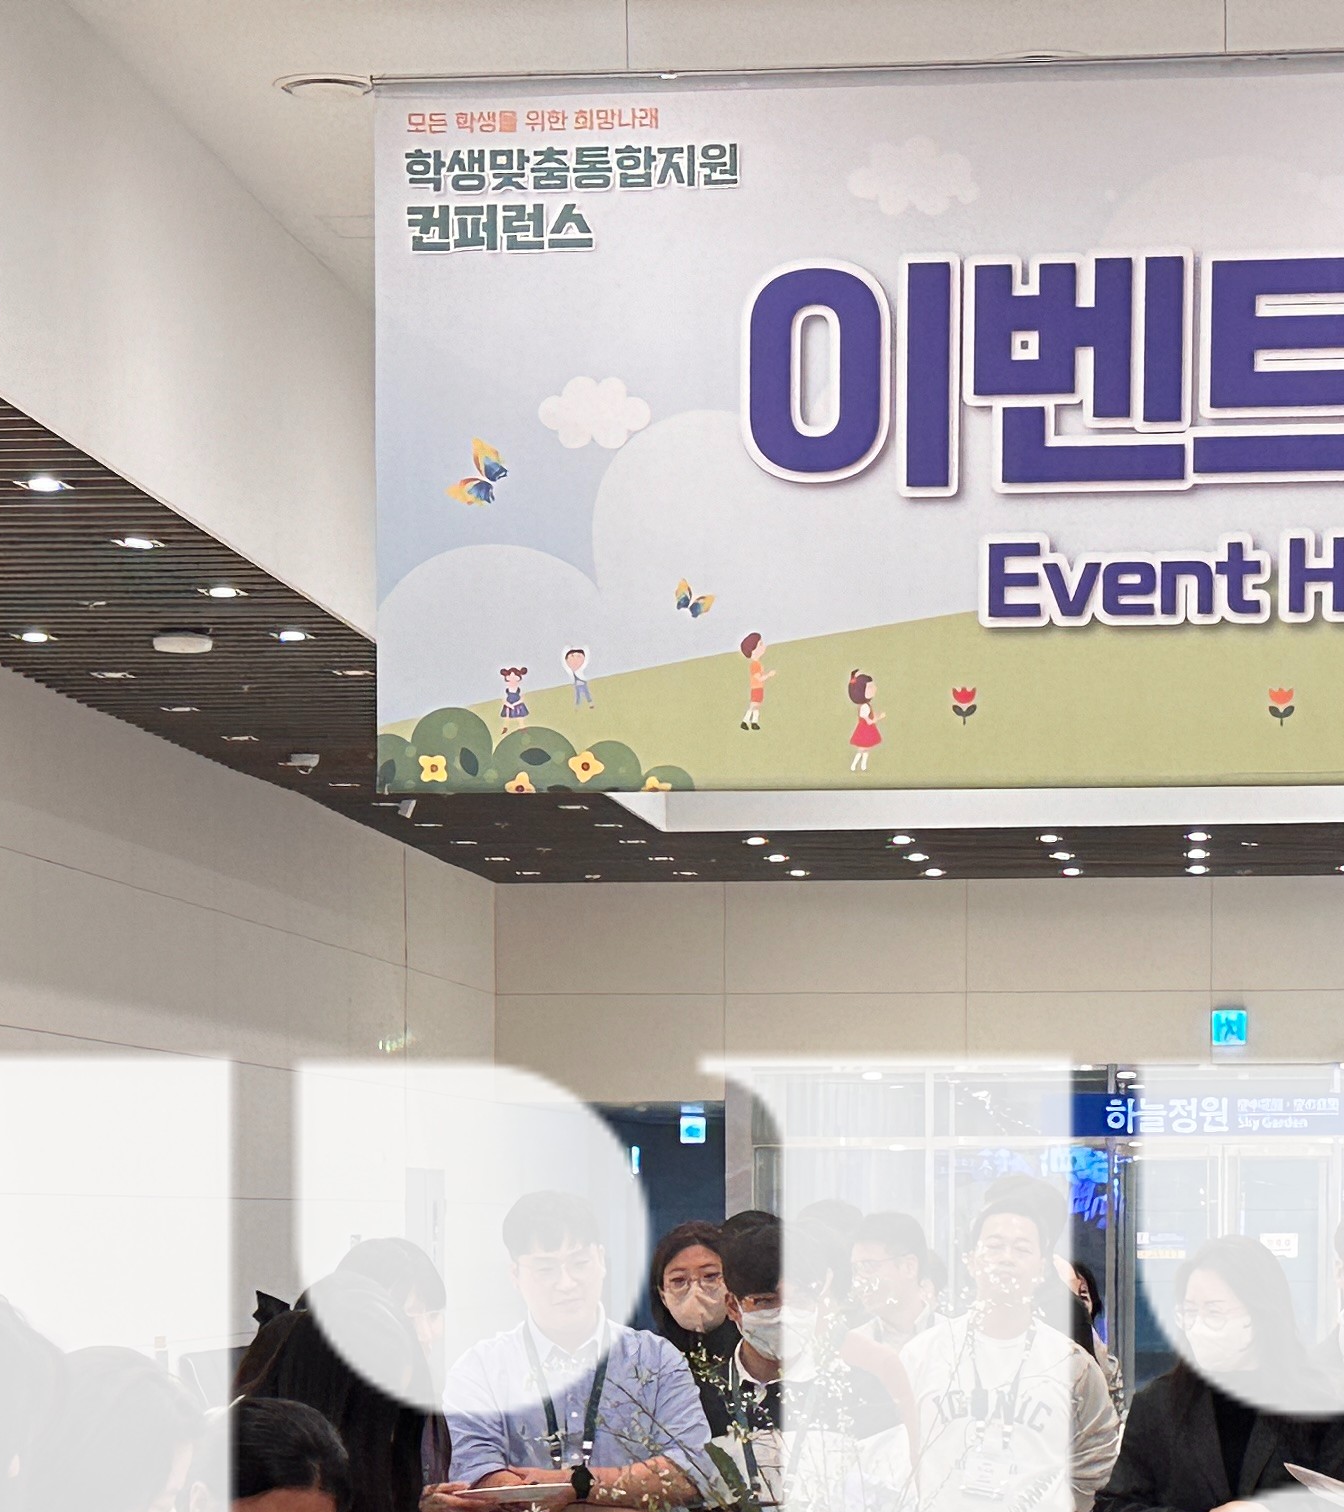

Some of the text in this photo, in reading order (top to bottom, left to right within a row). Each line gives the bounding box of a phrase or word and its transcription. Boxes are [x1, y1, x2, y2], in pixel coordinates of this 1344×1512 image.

[407, 111, 448, 134] 모든
[525, 108, 568, 132] 위한
[574, 107, 659, 131] 희망나래
[405, 143, 741, 194] 학생맞춤통합지원
[407, 203, 594, 252] 컨퍼런스
[987, 541, 1270, 620] Event
[1105, 1097, 1229, 1135] 하늘정원
